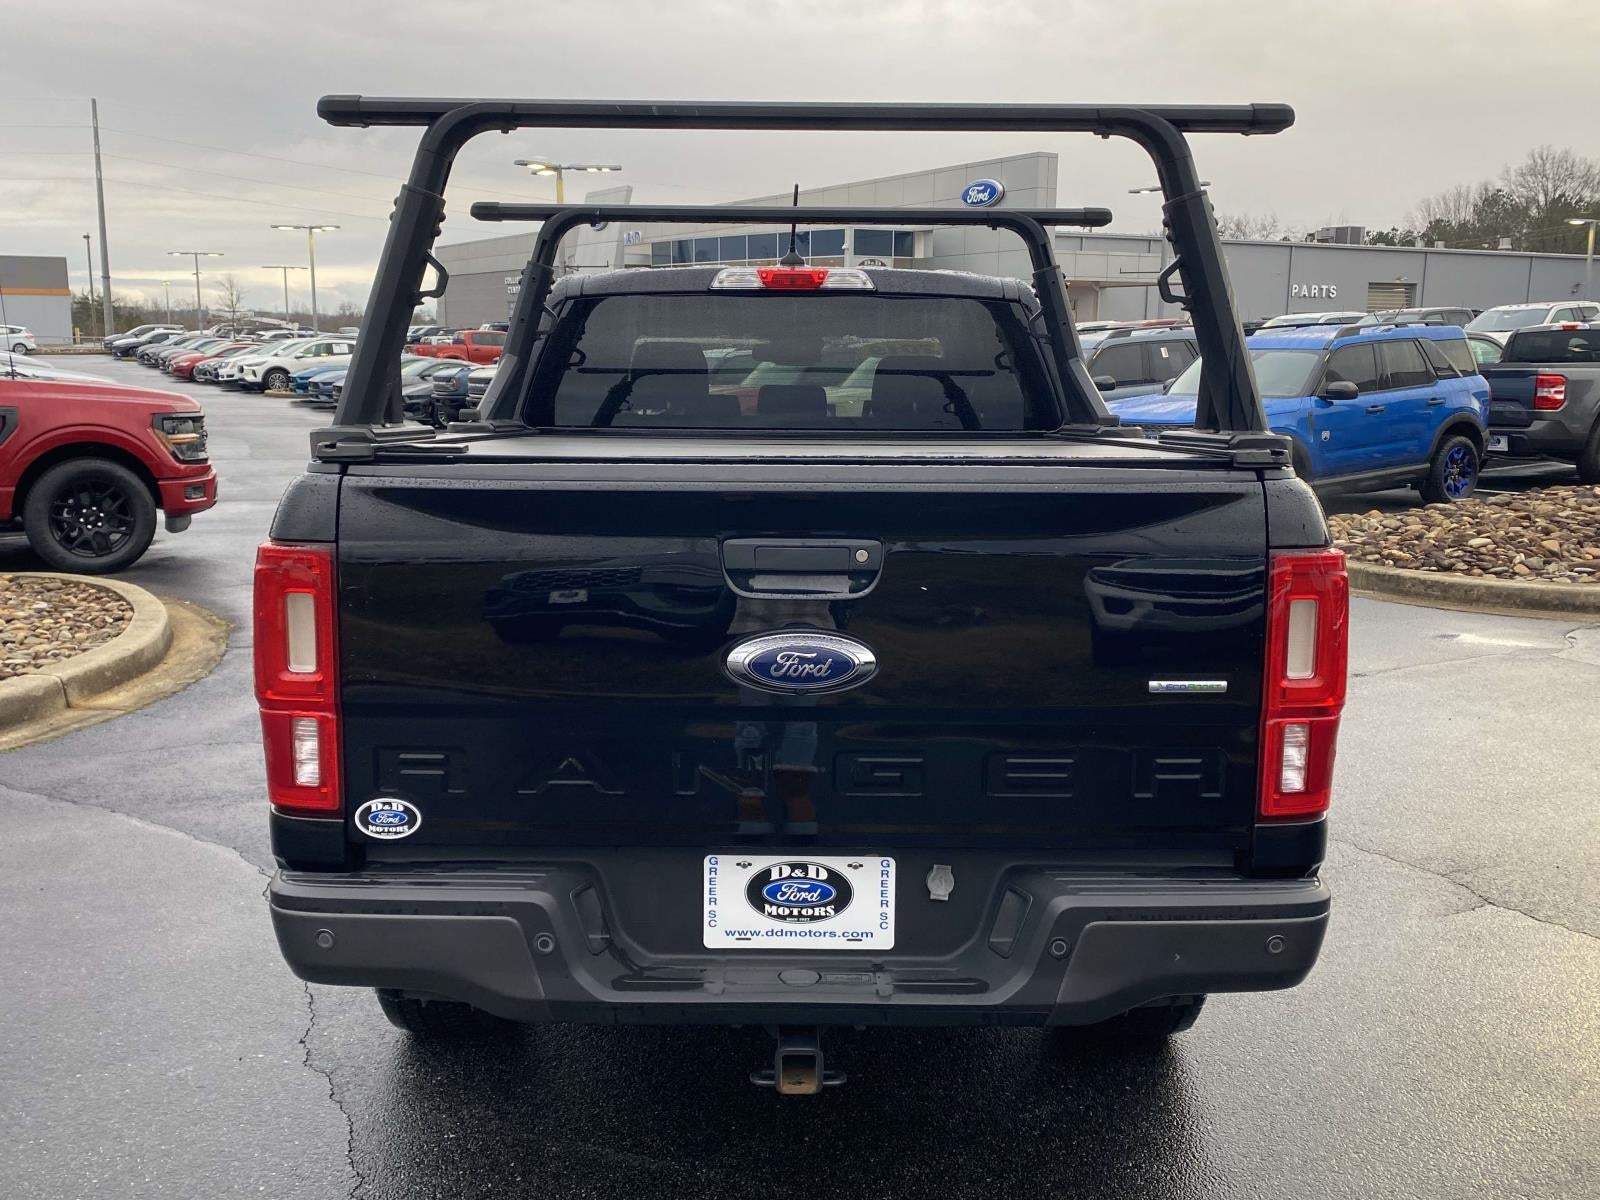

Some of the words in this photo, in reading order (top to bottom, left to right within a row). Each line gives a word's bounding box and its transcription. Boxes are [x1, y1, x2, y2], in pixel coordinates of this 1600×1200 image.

[966, 185, 991, 203] Ford
[1291, 284, 1337, 298] PARTS
[770, 651, 833, 677] Ford
[374, 745, 1228, 799] RANGER
[370, 802, 405, 813] D&D
[375, 813, 400, 825] Ford
[368, 825, 409, 833] MOTORS
[708, 856, 719, 906] GREER
[769, 864, 829, 881] D&D
[776, 882, 822, 901] Ford
[880, 859, 891, 908] GREER
[708, 909, 718, 928] SC
[763, 903, 836, 917] MOTORS
[879, 911, 889, 930] SC
[724, 929, 874, 938] www.ddmotors.com
